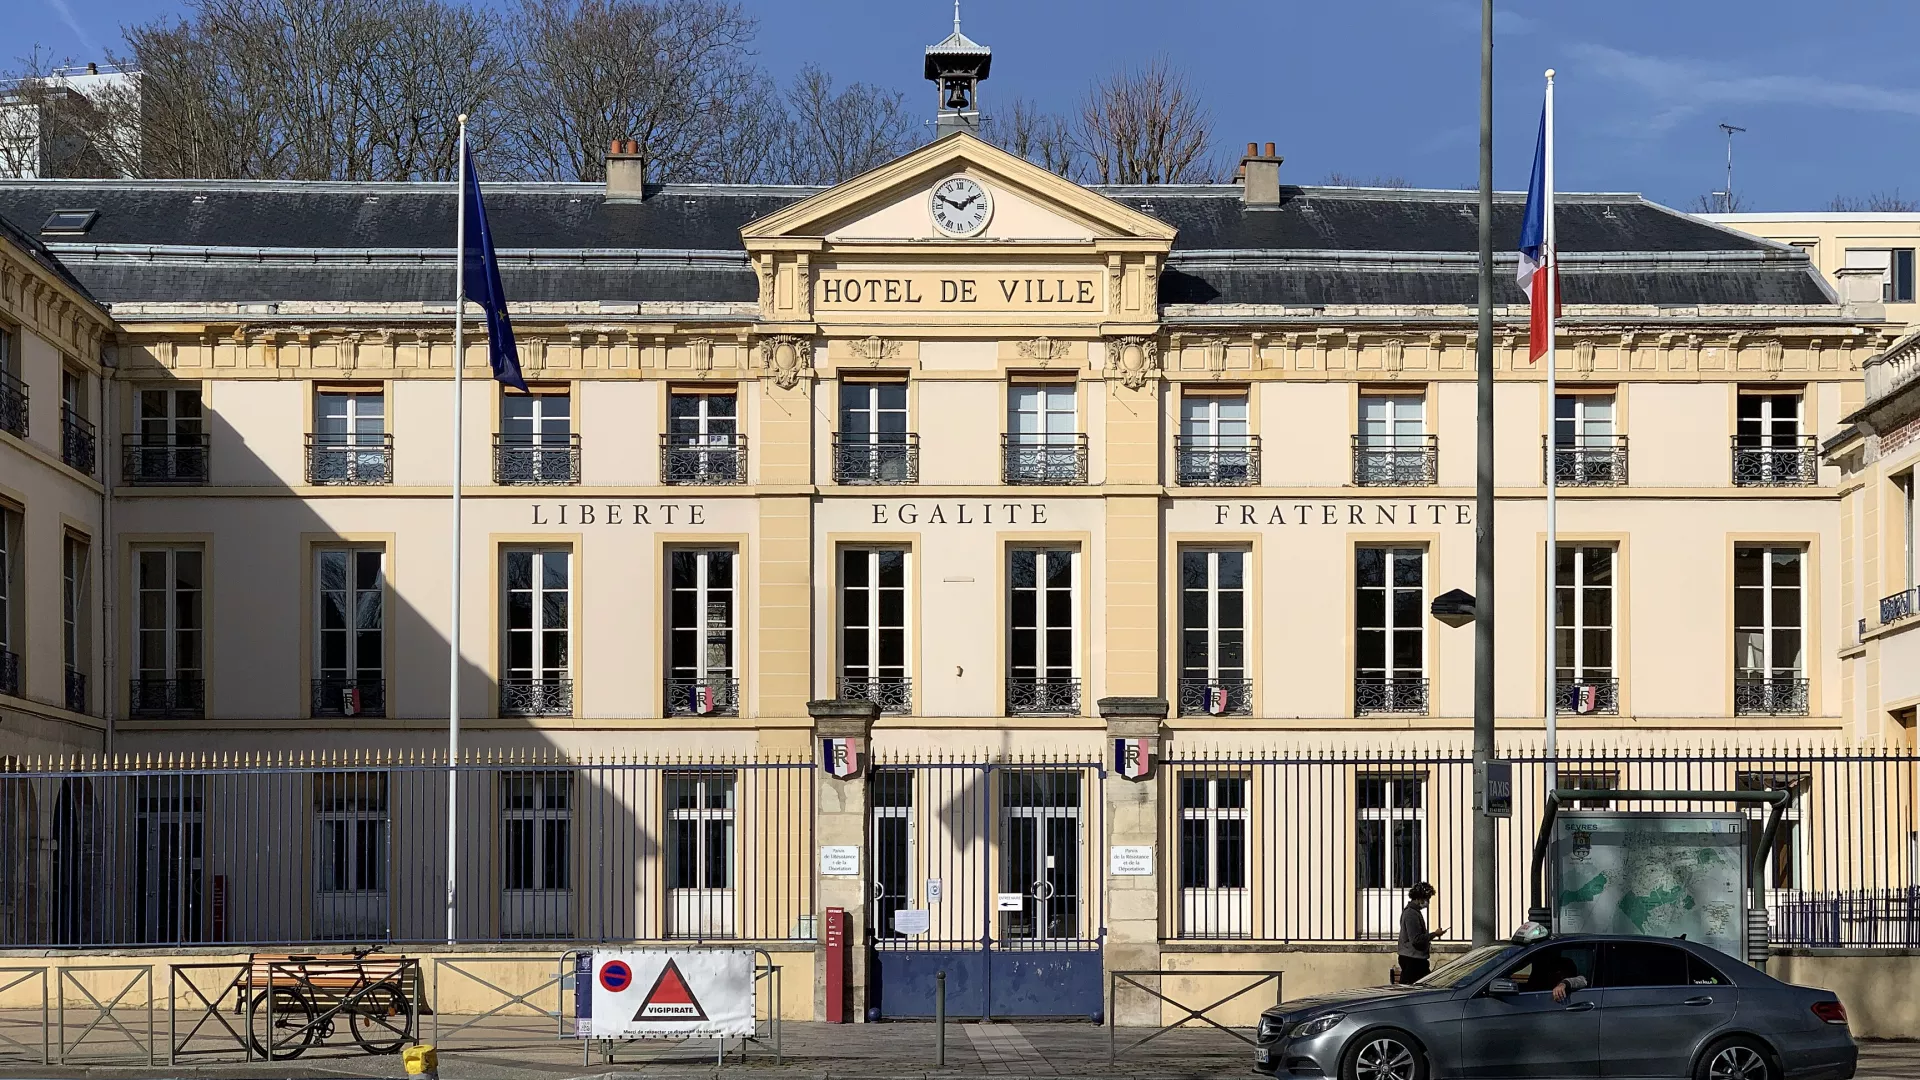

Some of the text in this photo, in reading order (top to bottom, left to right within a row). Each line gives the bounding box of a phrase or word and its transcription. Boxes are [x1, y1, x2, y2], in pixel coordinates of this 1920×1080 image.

[823, 279, 1095, 304] HOTEL DE VILLE
[531, 504, 706, 525] LIBERTE
[872, 503, 1048, 525] EGALITE
[1213, 504, 1472, 525] FRATERNITE
[1488, 780, 1510, 797] TAXIS
